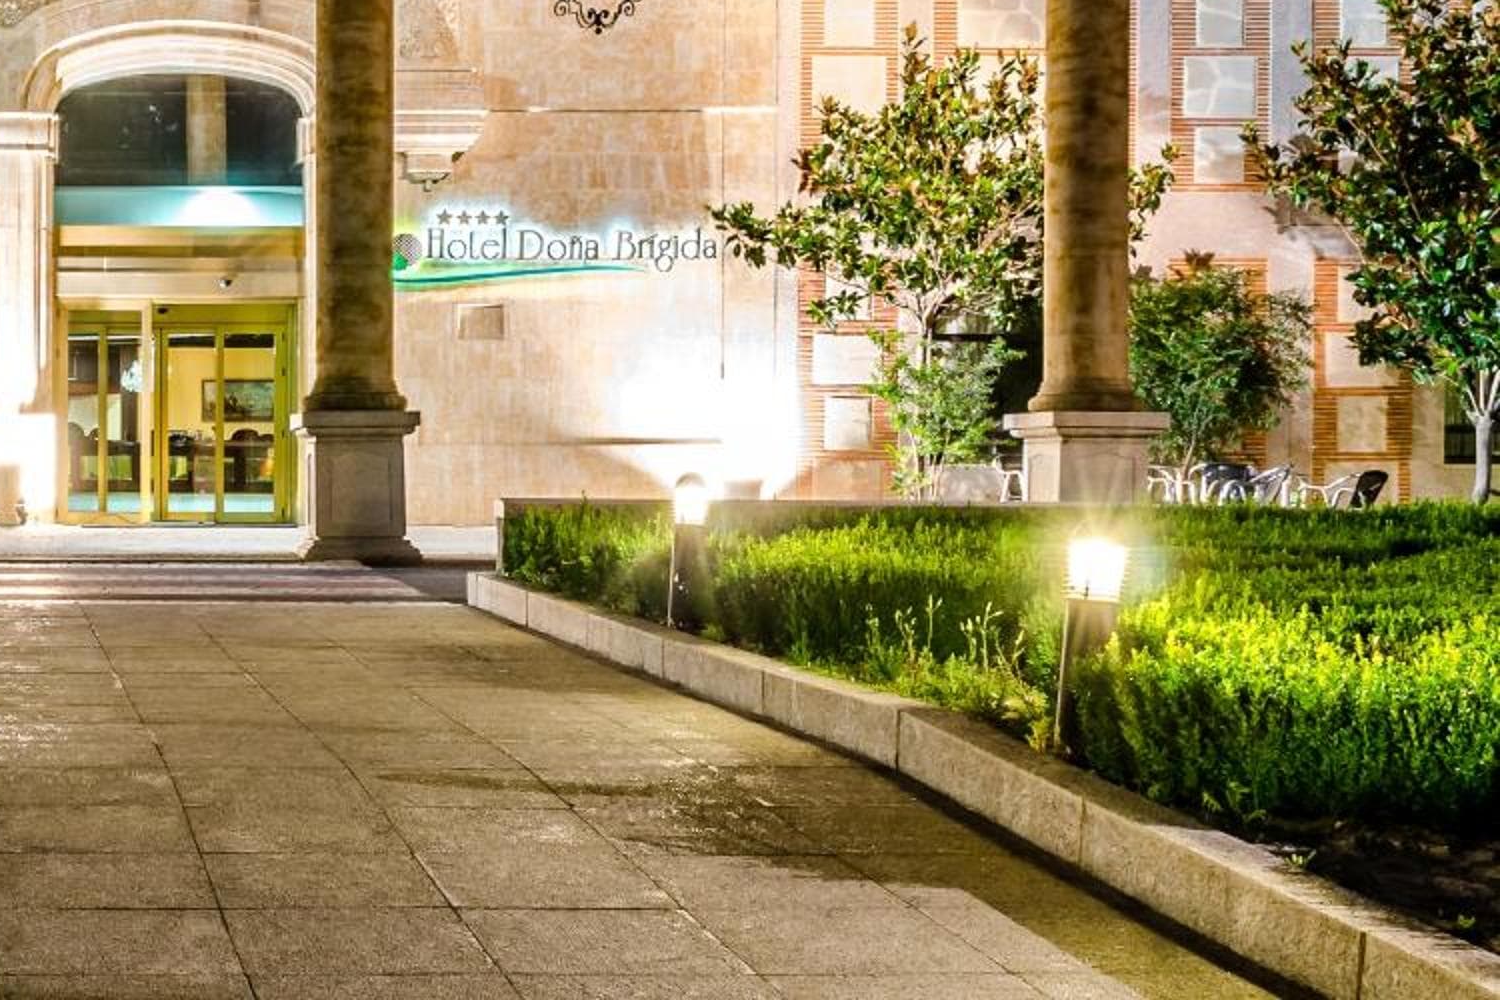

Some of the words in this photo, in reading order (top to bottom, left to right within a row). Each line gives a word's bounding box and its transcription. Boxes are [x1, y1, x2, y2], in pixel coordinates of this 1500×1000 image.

[426, 226, 507, 260] Hotel
[515, 229, 599, 261] Doña
[612, 227, 717, 272] Brígida
